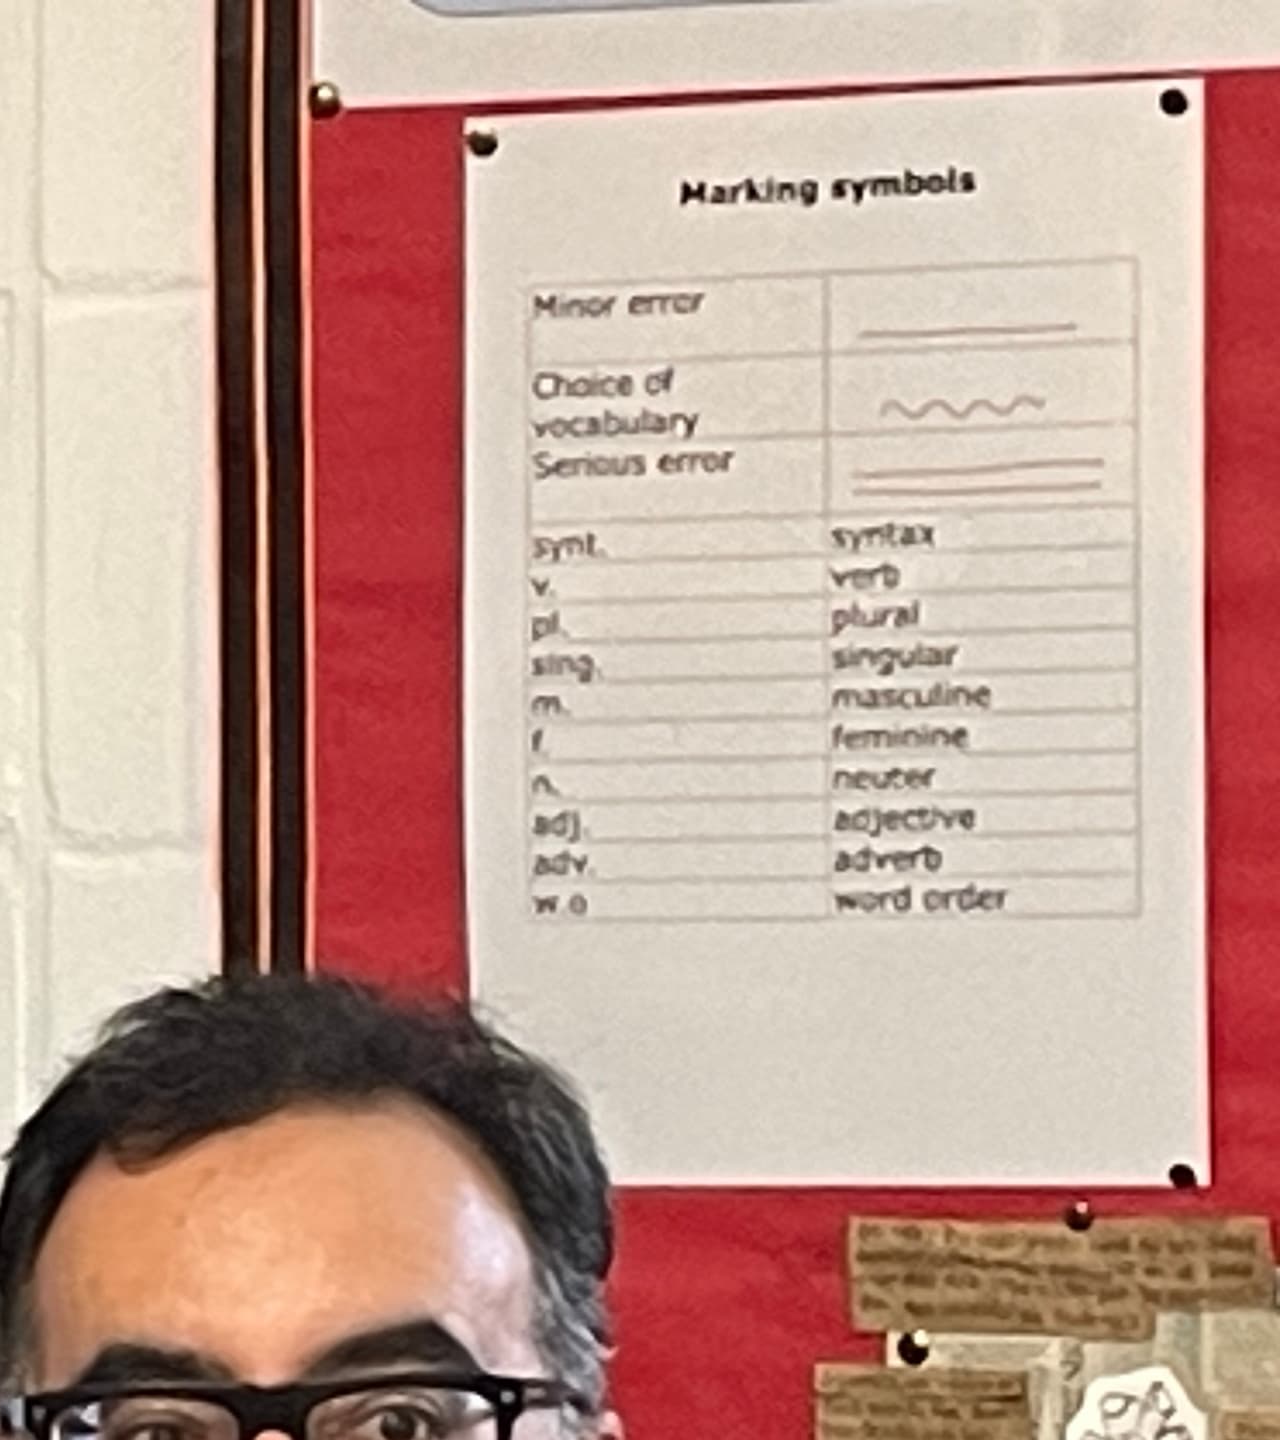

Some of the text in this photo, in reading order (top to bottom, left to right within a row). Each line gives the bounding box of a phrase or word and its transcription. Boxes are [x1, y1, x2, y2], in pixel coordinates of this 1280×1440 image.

[679, 165, 977, 209] Marking symbols
[532, 291, 705, 318] Minor error
[532, 367, 674, 400] Choice of
[532, 409, 699, 441] vocabulary
[532, 449, 734, 479] Serious error
[831, 523, 935, 554] syntax
[831, 563, 902, 590] verb
[831, 602, 921, 635] plural
[831, 642, 959, 676] singular
[831, 682, 992, 710] masculine
[831, 723, 969, 750] feminine
[833, 765, 935, 791] neuter
[833, 803, 977, 836] adjective
[833, 845, 943, 873] adverb
[834, 885, 1007, 914] word order
